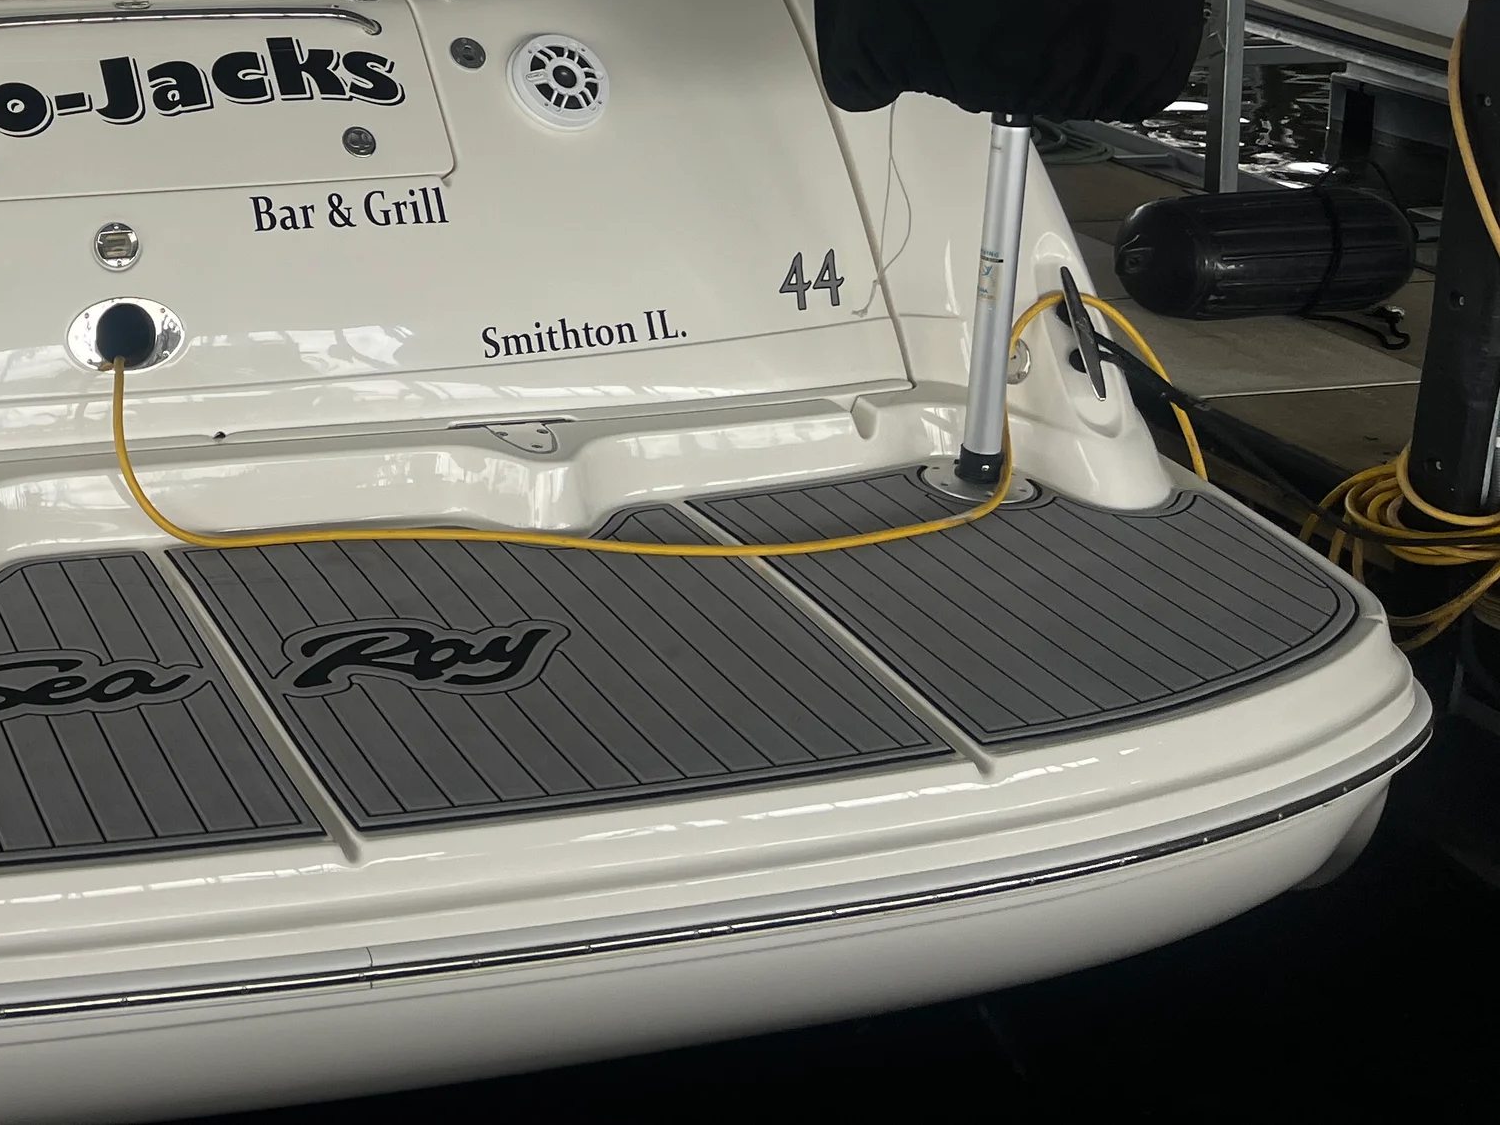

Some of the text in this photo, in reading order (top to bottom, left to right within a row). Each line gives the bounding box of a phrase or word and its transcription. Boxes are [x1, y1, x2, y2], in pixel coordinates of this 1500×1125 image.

[249, 187, 449, 232] Bar & Grill
[779, 248, 844, 311] 44
[481, 309, 688, 359] Smithton IL.
[292, 626, 552, 688] Ray
